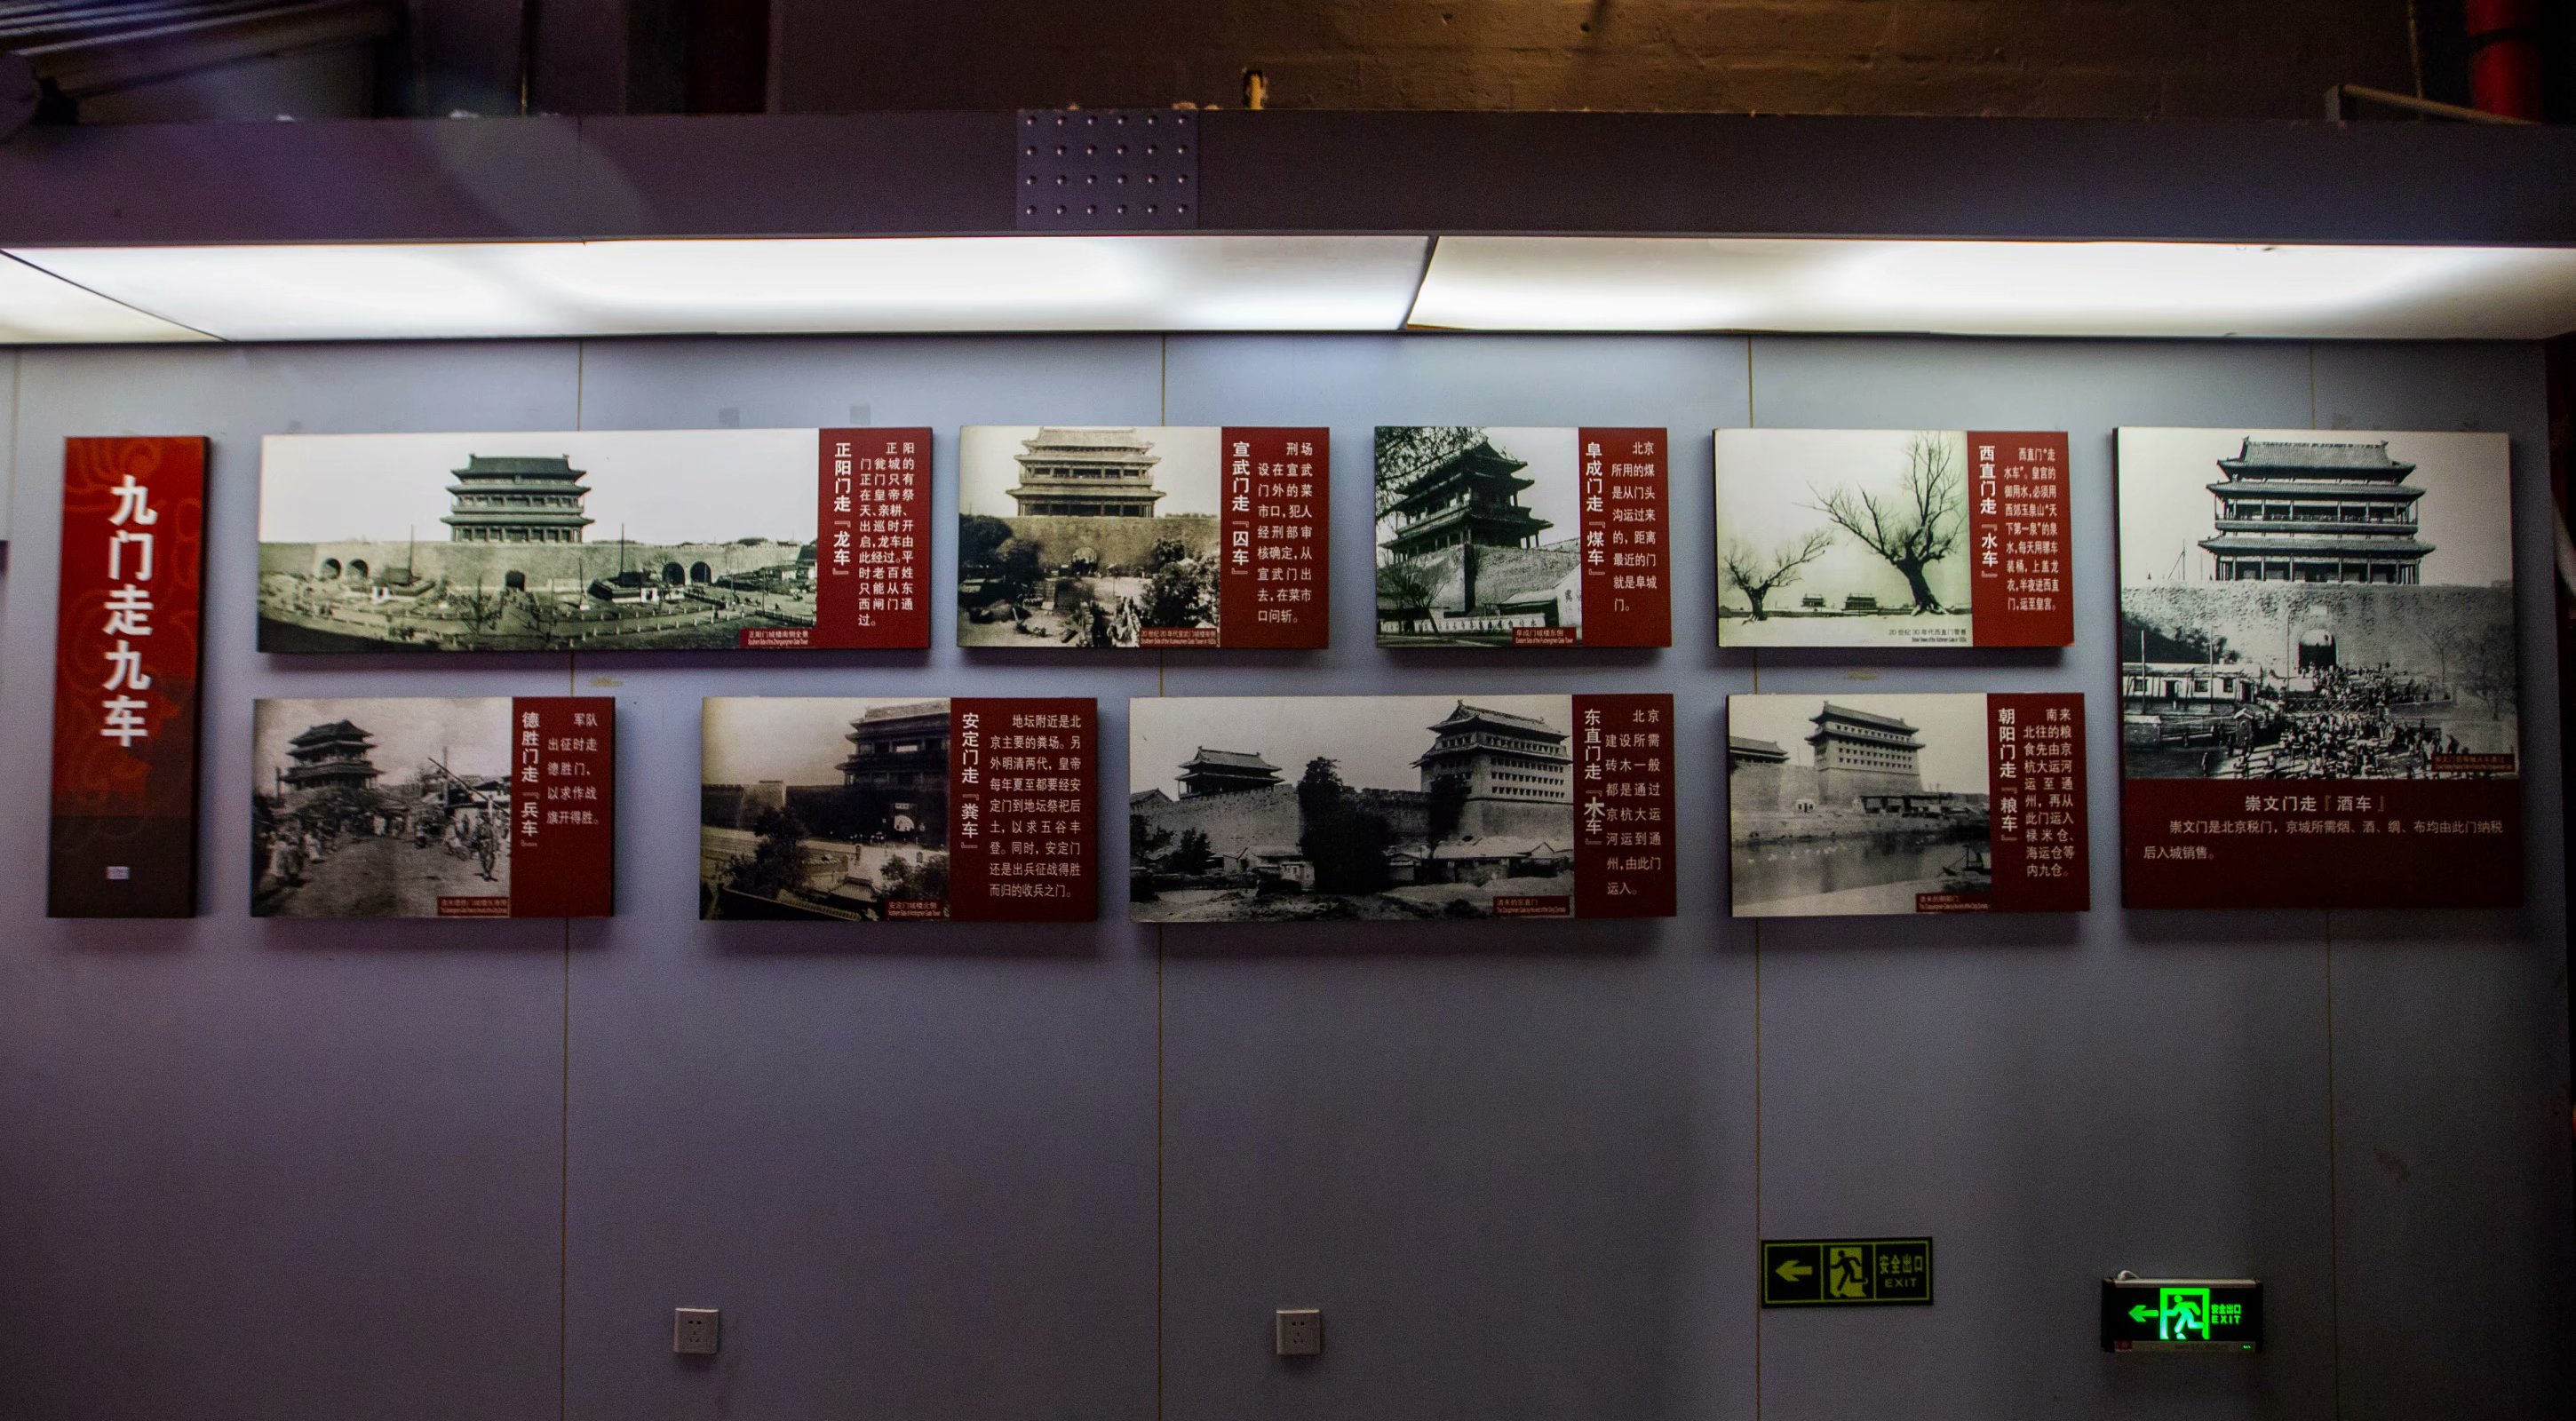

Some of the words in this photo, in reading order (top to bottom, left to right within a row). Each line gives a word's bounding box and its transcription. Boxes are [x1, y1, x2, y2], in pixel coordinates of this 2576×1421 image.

[886, 442, 914, 455] 正阳
[1286, 442, 1312, 456] 刑场
[1633, 441, 1654, 455] 北京
[861, 458, 914, 471] 门瓮城的
[1258, 463, 1312, 476] 设在宣武
[1612, 464, 1654, 477] 所用的煤
[860, 473, 914, 486] 正门只有
[860, 489, 914, 501] 在皇帝祭
[1259, 483, 1312, 497] 门外的菜
[1612, 486, 1655, 499] 是从门头
[1613, 508, 1656, 521] 沟运过来
[860, 520, 913, 532] 出巡时开
[1258, 526, 1312, 539] 经刑部审
[1613, 553, 1656, 567] 最近的门
[859, 567, 912, 579] 时老百姓
[1258, 568, 1311, 581] 宣武门出
[859, 583, 912, 595] 只能从东
[1614, 576, 1657, 589] 就是阜城
[101, 474, 157, 747] 九门走九车
[859, 599, 912, 610] 西闸门通
[574, 713, 597, 726] 军队
[1013, 714, 1081, 727] 地坛附近是北
[1633, 709, 1659, 723] 北京
[2047, 708, 2071, 721] 南来
[2023, 725, 2071, 739] 北往的粮
[548, 737, 597, 751] 出征时走
[1606, 734, 1659, 747] 建设所需
[2023, 742, 2071, 756] 食先由京
[1606, 758, 1660, 772] 砖木一般
[2024, 760, 2071, 774] 杭大运河
[990, 778, 1080, 791] 每年夏至都要经安
[1606, 782, 1660, 796] 都是通过
[2025, 777, 2072, 790] 运至通
[548, 786, 597, 800] 以求作战
[990, 798, 1080, 813] 定门到地坛祭祀后
[1607, 807, 1660, 822] 京杭大运
[2026, 812, 2073, 825] 此门运入
[1607, 832, 1660, 845] 河运到通
[2027, 845, 2074, 860] 海运仓等
[990, 862, 1080, 876] 还是出兵征战得胜
[1880, 1255, 1922, 1274] 安全出口
[1885, 1278, 1917, 1288] EXIT
[2212, 1304, 2240, 1314] 安全出口
[2212, 1315, 2240, 1324] EXIT
